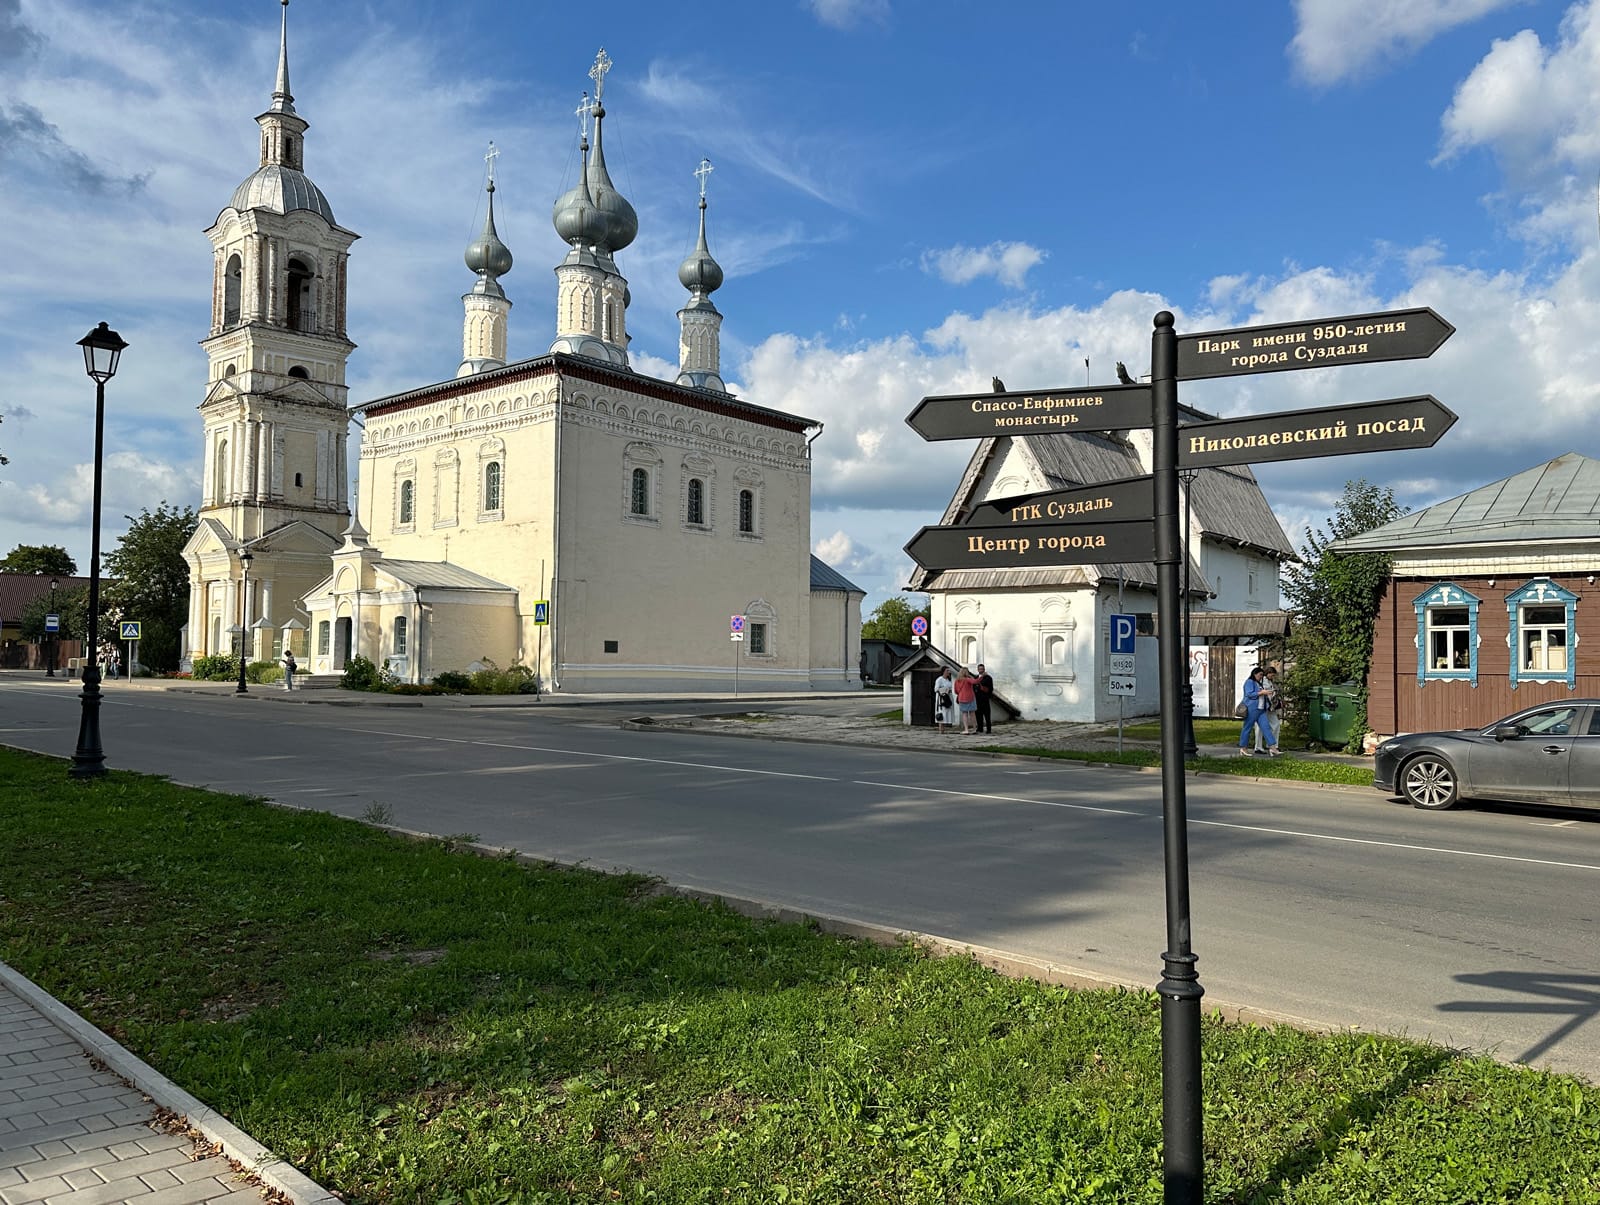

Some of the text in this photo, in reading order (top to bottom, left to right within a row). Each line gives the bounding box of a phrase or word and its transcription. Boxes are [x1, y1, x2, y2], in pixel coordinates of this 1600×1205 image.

[1197, 321, 1406, 354] Парк имени 950-летия
[1231, 343, 1369, 369] города Суздаля
[971, 395, 1104, 413] Спасо-Евфимиев
[994, 413, 1080, 427] монастырь
[1189, 416, 1425, 454] Николаевский посад
[1011, 497, 1114, 522] ГТК Суздаль
[967, 535, 1106, 554] Центр города
[1117, 619, 1132, 649] P
[1125, 660, 1133, 668] 20
